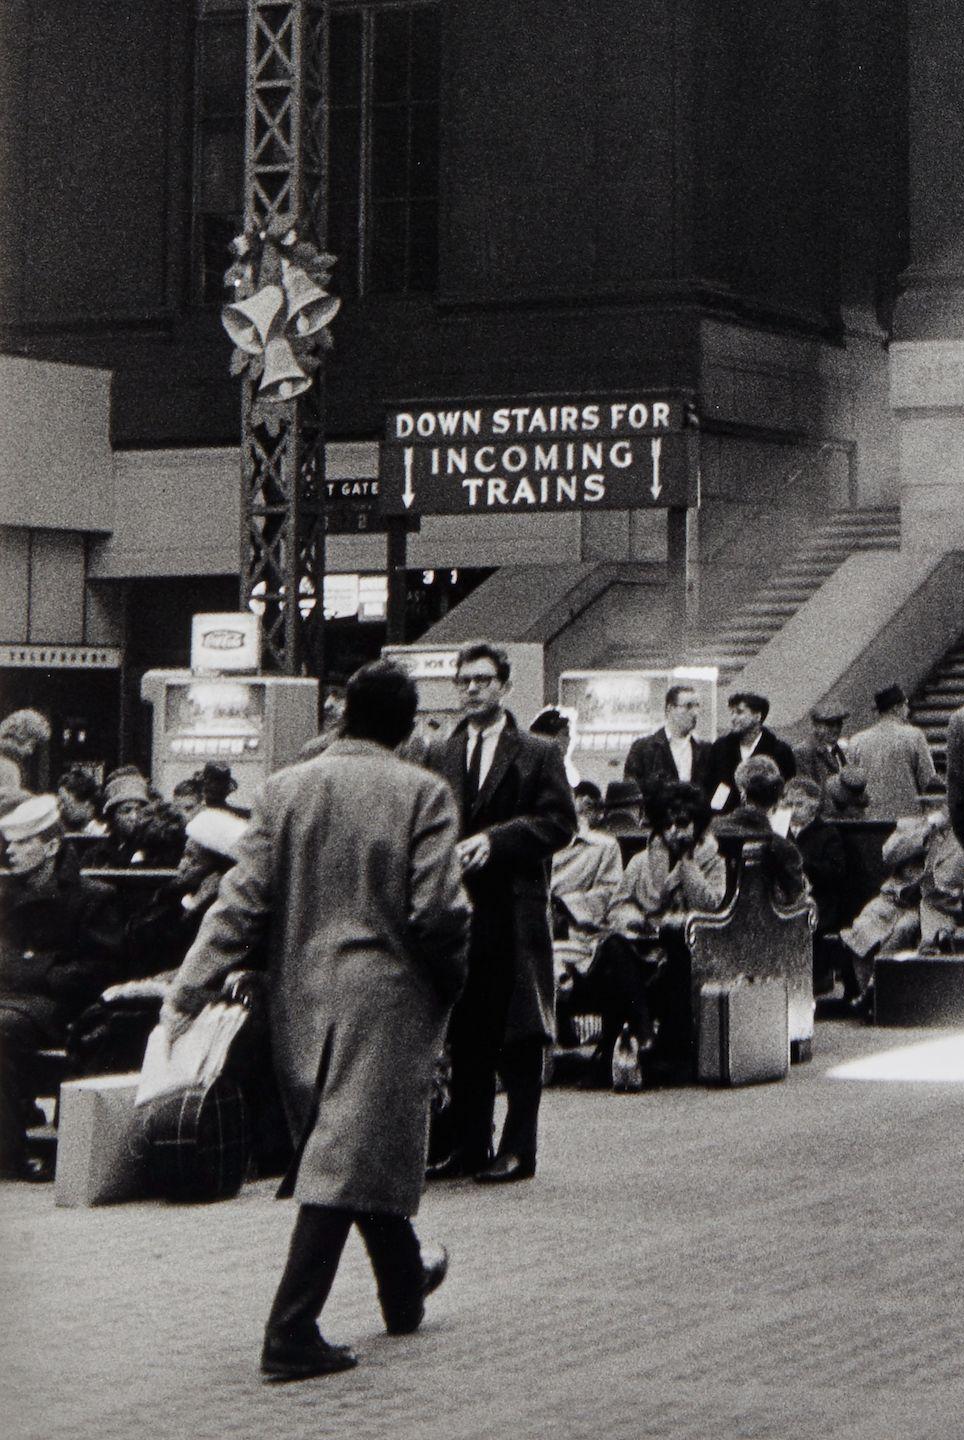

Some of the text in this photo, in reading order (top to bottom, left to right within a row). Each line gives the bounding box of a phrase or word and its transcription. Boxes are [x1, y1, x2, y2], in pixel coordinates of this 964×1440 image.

[396, 402, 671, 438] DOWN STAIRS FOR
[431, 441, 633, 474] INCOMING
[341, 481, 379, 496] GATE
[462, 474, 606, 506] TRAINS
